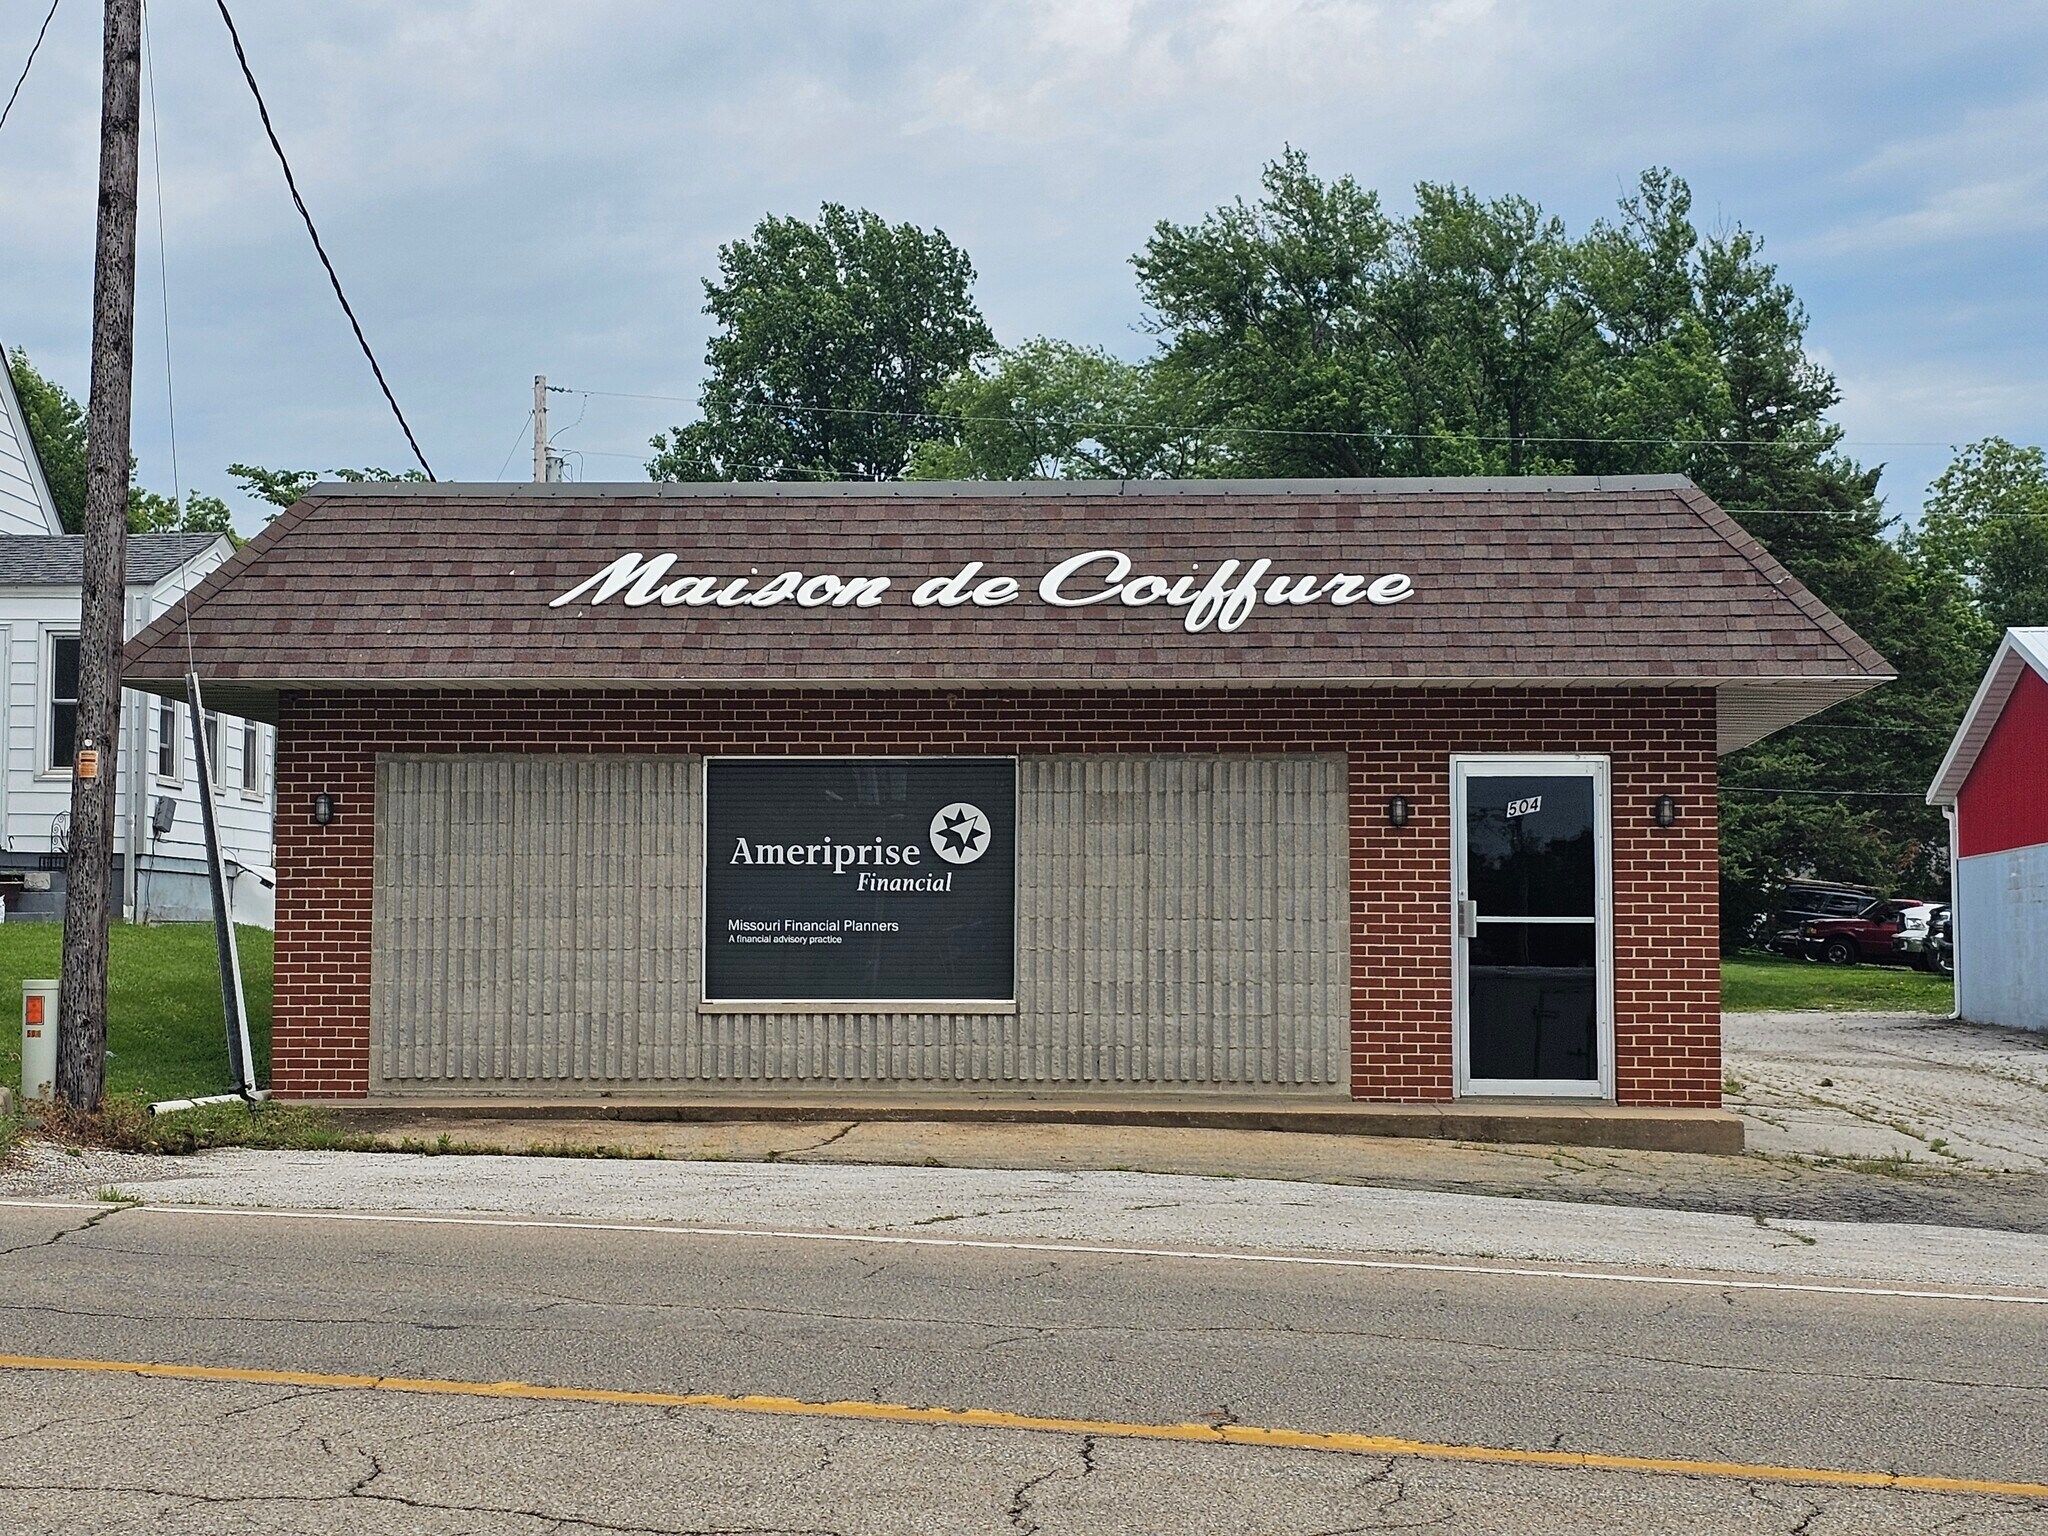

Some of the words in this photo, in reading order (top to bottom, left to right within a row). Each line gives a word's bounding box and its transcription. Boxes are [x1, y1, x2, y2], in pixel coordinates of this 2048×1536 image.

[549, 552, 892, 608] Maison
[911, 561, 1020, 607] de
[1038, 550, 1416, 633] Coiffure
[1509, 797, 1539, 816] 504
[729, 836, 921, 874] Ameriprise
[856, 872, 952, 892] Financial
[728, 919, 781, 932] Missouri
[784, 919, 840, 932] Financial
[844, 919, 899, 932] Planners
[728, 935, 735, 943] A
[736, 934, 772, 944] financial
[773, 935, 808, 945] advisory
[809, 935, 843, 945] practice
